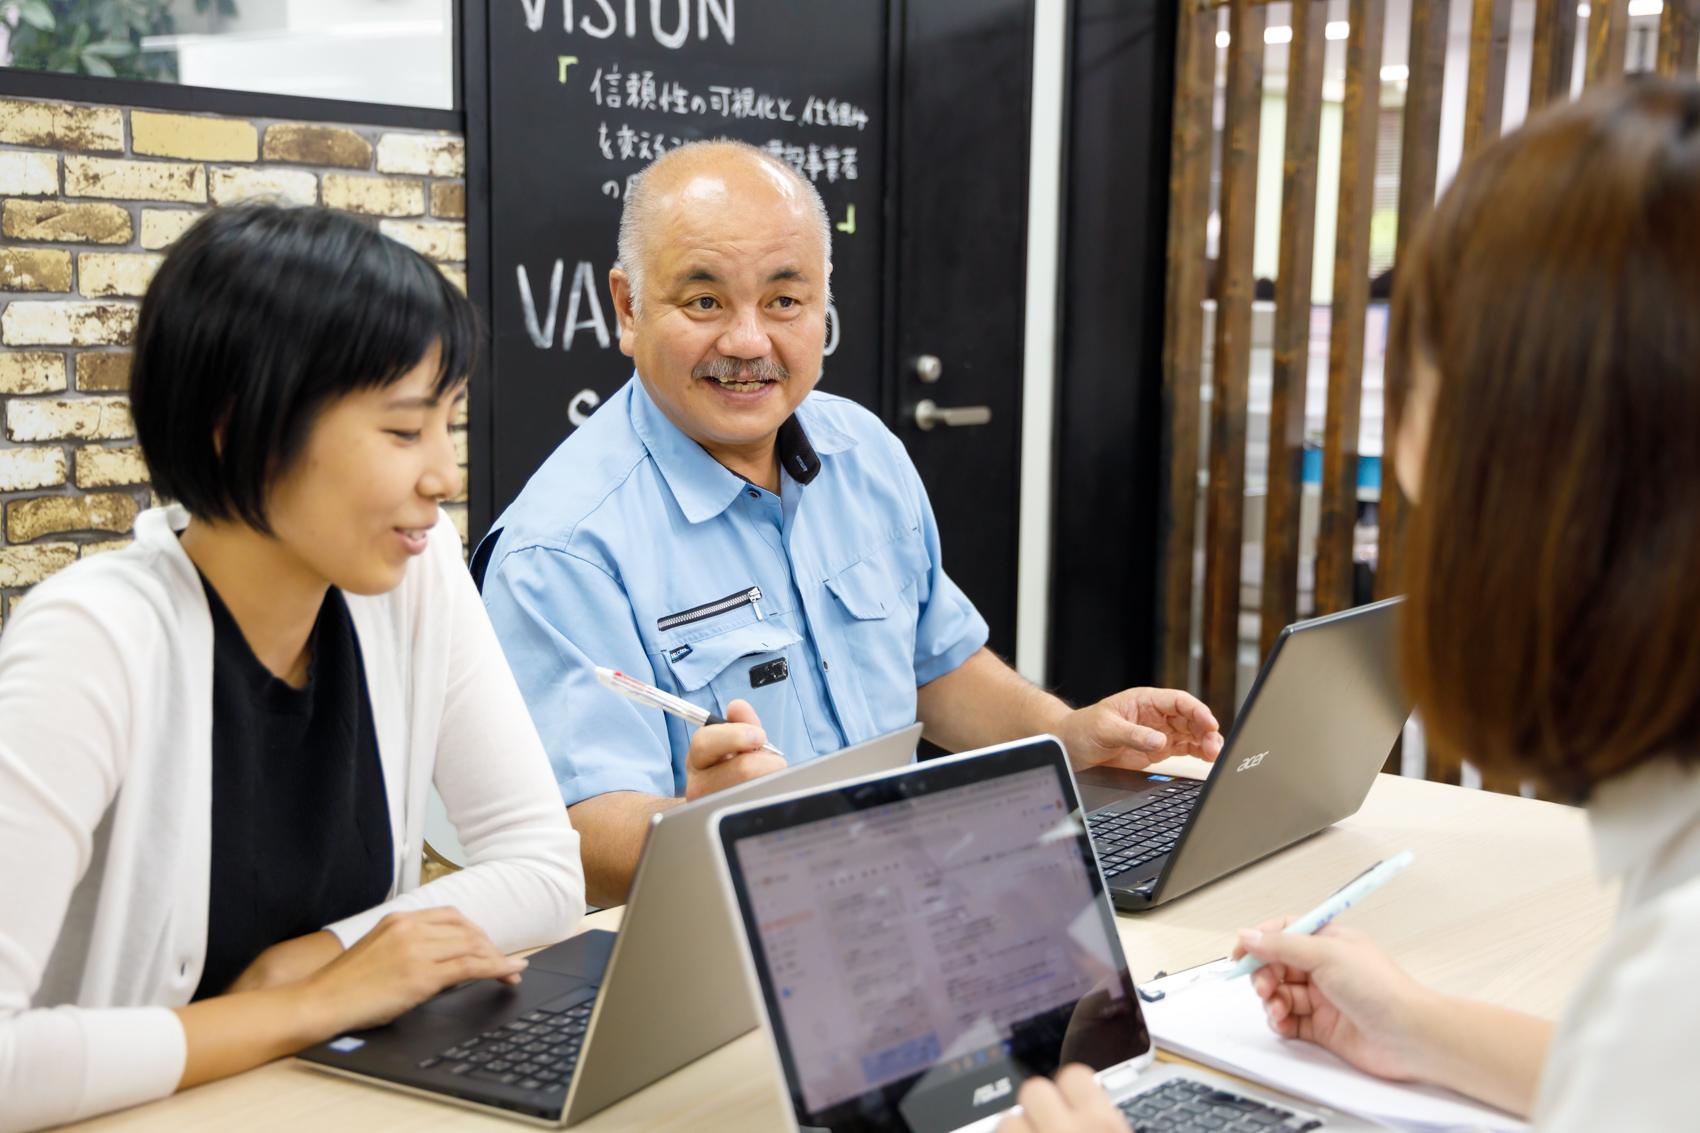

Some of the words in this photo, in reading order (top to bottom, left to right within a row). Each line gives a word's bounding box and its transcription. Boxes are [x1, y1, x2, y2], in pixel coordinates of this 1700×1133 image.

[521, 0, 736, 49] VISION
[598, 121, 682, 160] を変える
[1236, 750, 1270, 773] acer
